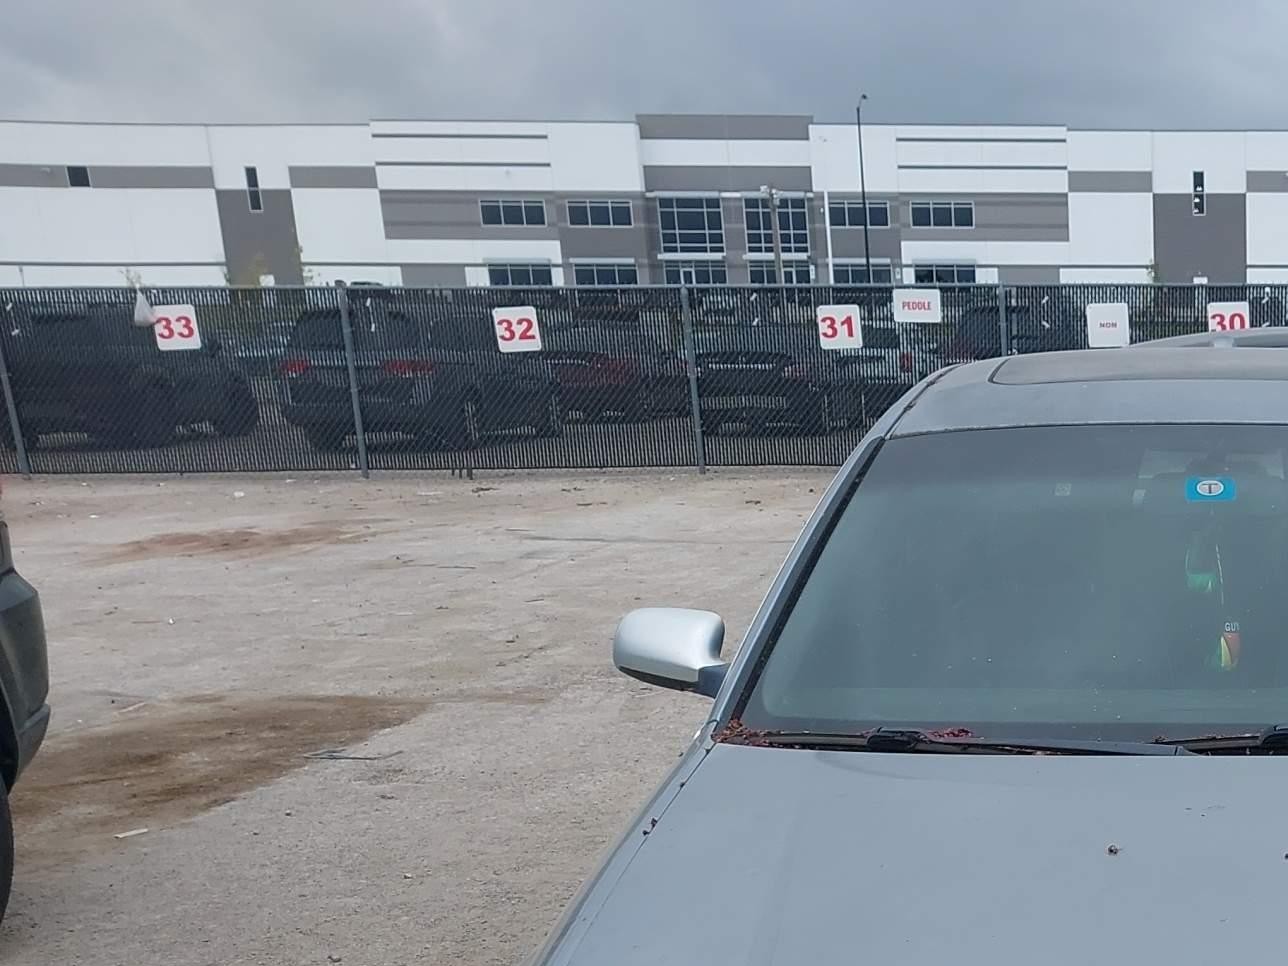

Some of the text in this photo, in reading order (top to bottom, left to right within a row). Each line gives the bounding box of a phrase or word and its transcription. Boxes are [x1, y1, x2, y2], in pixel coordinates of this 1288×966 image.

[902, 300, 932, 311] PEDDLE
[155, 316, 194, 339] 33
[497, 318, 536, 341] 32
[821, 316, 854, 338] 31
[1211, 313, 1245, 330] 30
